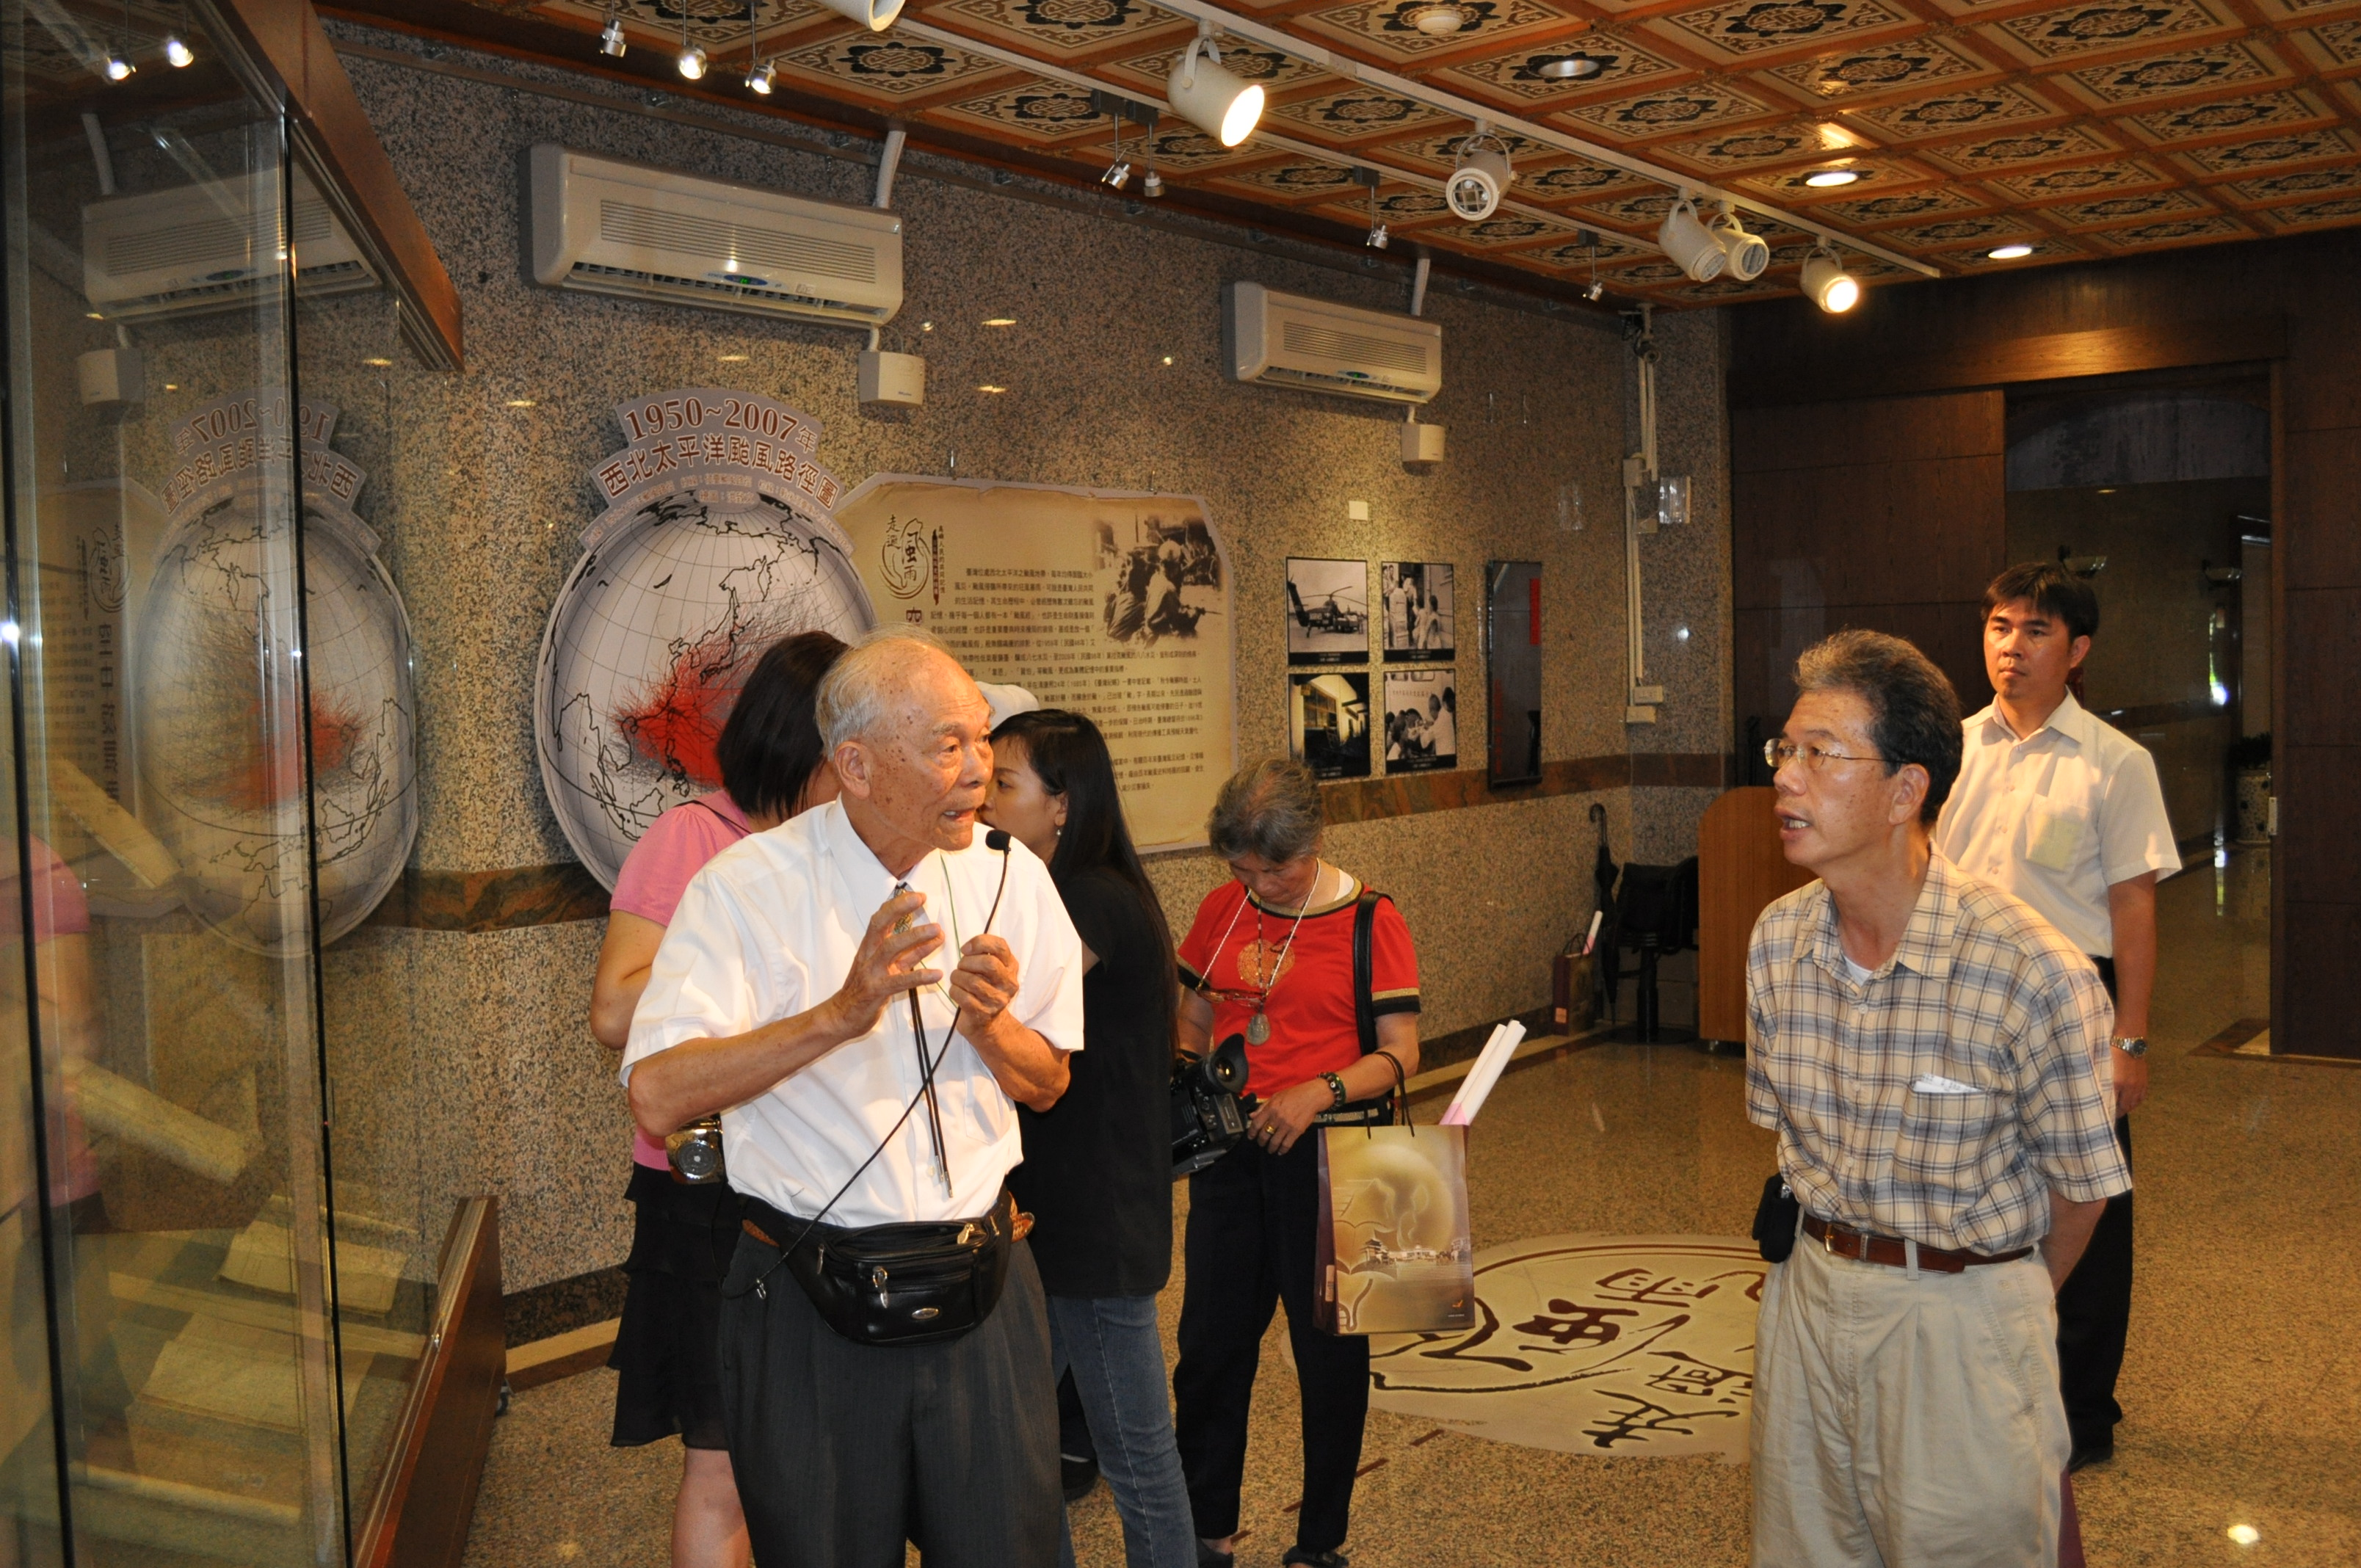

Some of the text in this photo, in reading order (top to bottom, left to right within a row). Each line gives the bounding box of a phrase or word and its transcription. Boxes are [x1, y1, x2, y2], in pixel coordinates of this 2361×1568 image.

[625, 397, 819, 454] 1950~2007年
[599, 433, 840, 510] 西北太平洋颱風路徑圖
